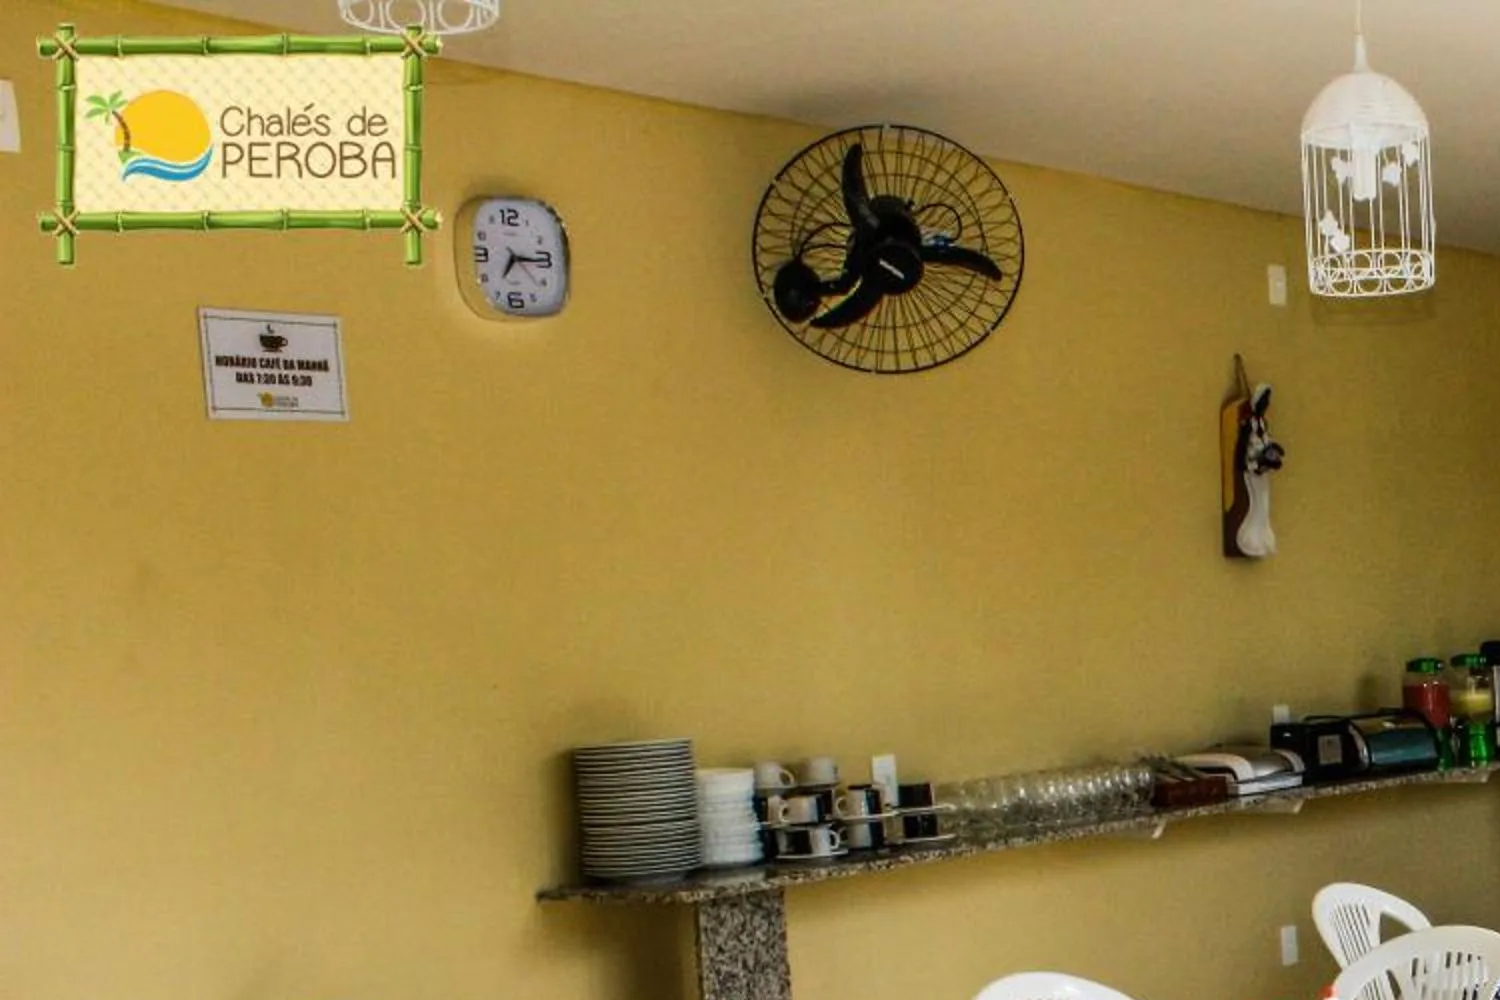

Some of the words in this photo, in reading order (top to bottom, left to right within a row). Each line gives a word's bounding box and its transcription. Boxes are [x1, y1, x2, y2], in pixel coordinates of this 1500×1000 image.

[499, 208, 520, 227] 12
[535, 251, 553, 269] 3
[507, 291, 525, 309] 6
